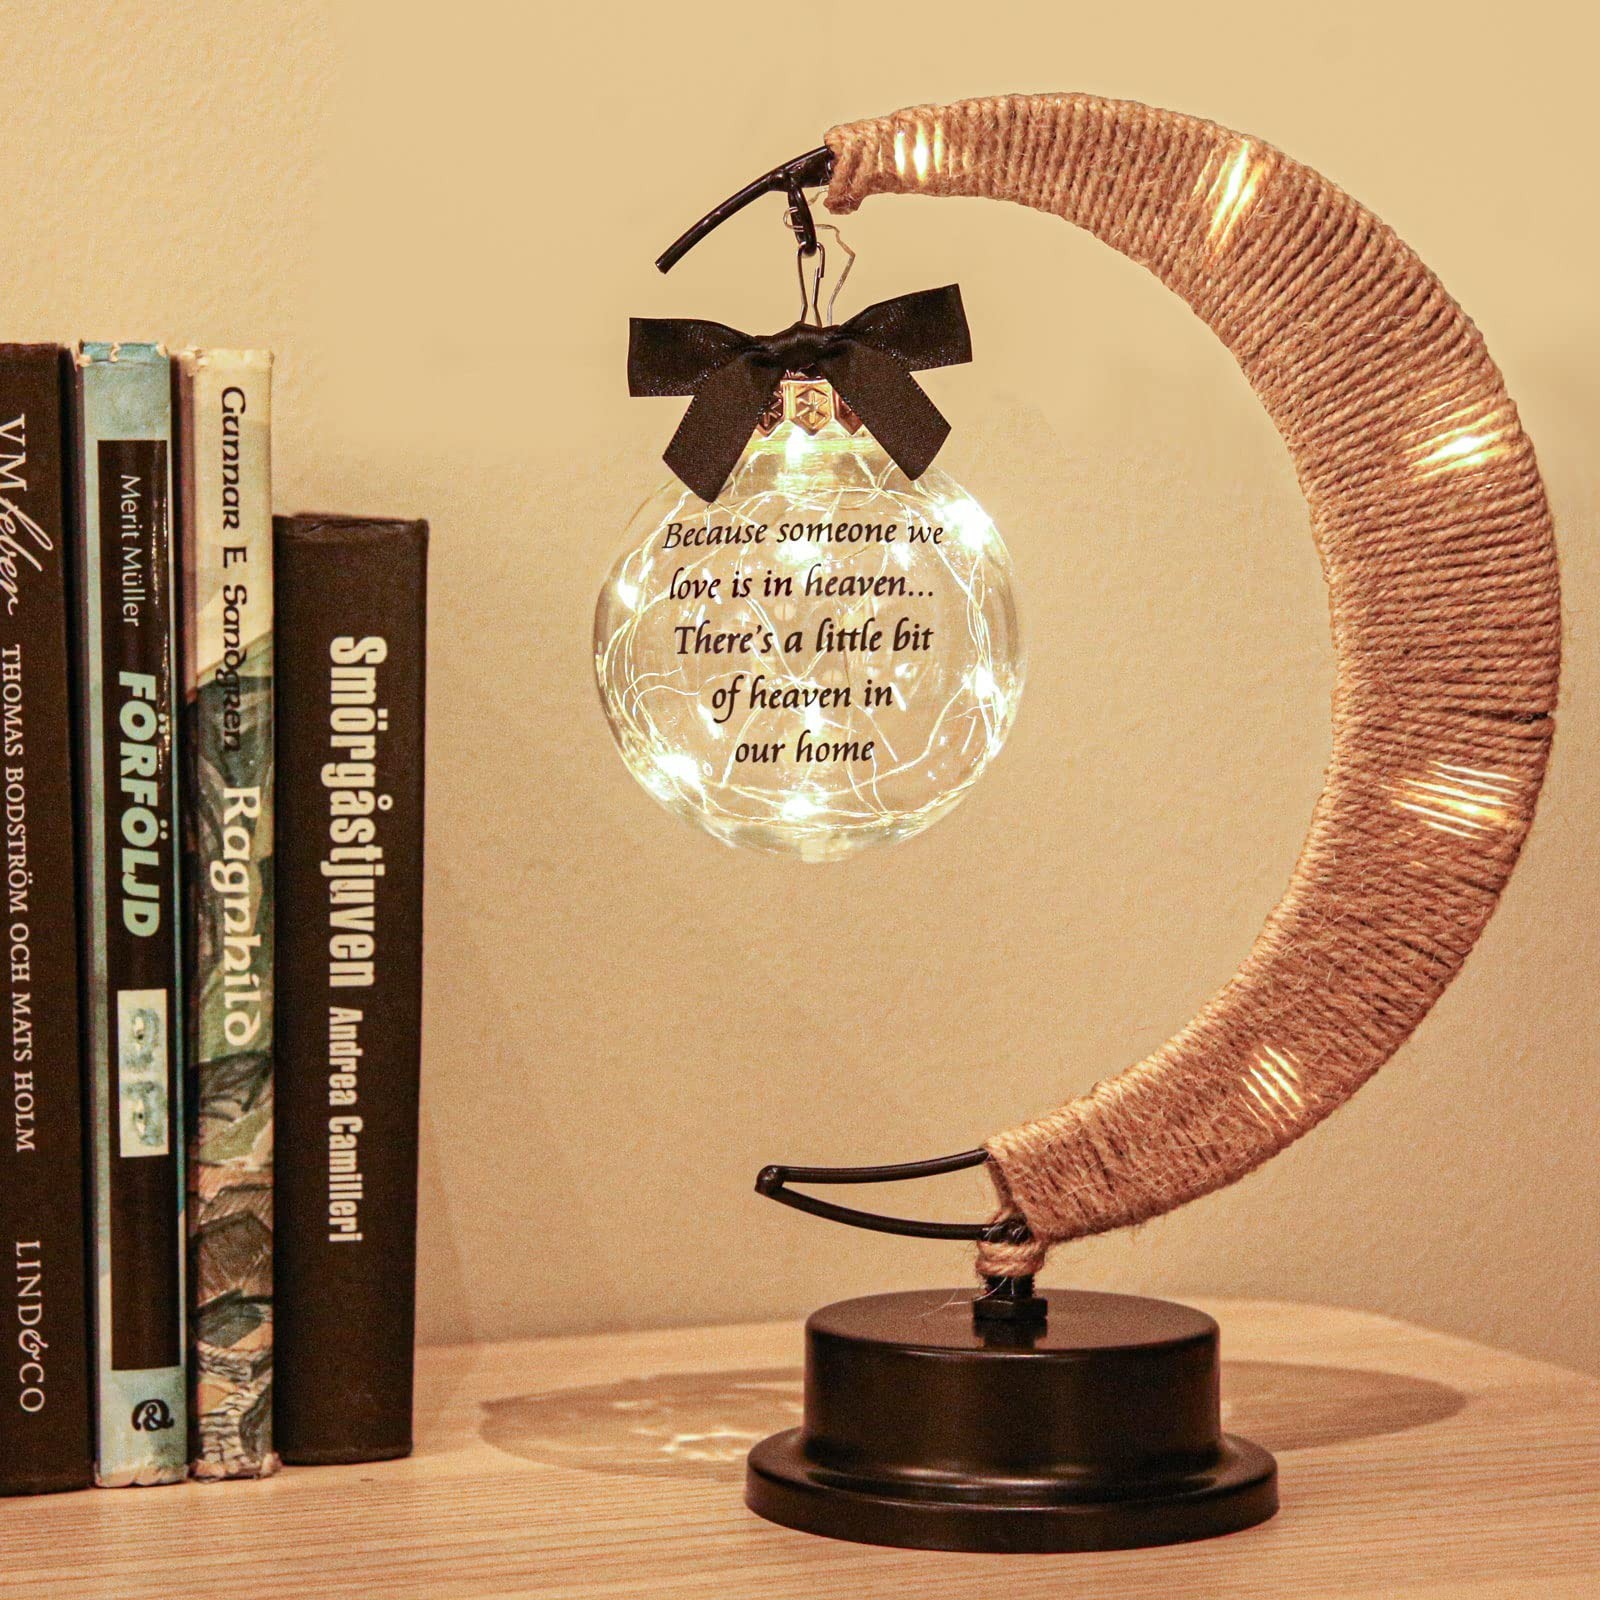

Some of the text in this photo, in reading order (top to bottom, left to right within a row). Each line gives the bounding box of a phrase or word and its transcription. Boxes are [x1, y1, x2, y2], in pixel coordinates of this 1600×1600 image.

[121, 474, 145, 627] Merit Müller
[214, 386, 248, 753] Gunnar E Sandgren
[661, 521, 944, 549] Because someone we
[669, 563, 934, 600] love is in heaven...
[674, 616, 934, 655] There's a little bit
[711, 674, 893, 724] of heaven in
[119, 670, 168, 937] FÖRFÖLJD
[321, 636, 393, 987] Smörgåstjuven
[735, 729, 875, 763] our home
[1, 643, 35, 1152] THOMAS BODSTRÖM OCH MATS HOLM
[210, 786, 262, 1046] Ragnhild
[328, 1006, 363, 1242] Andrea Camilleri
